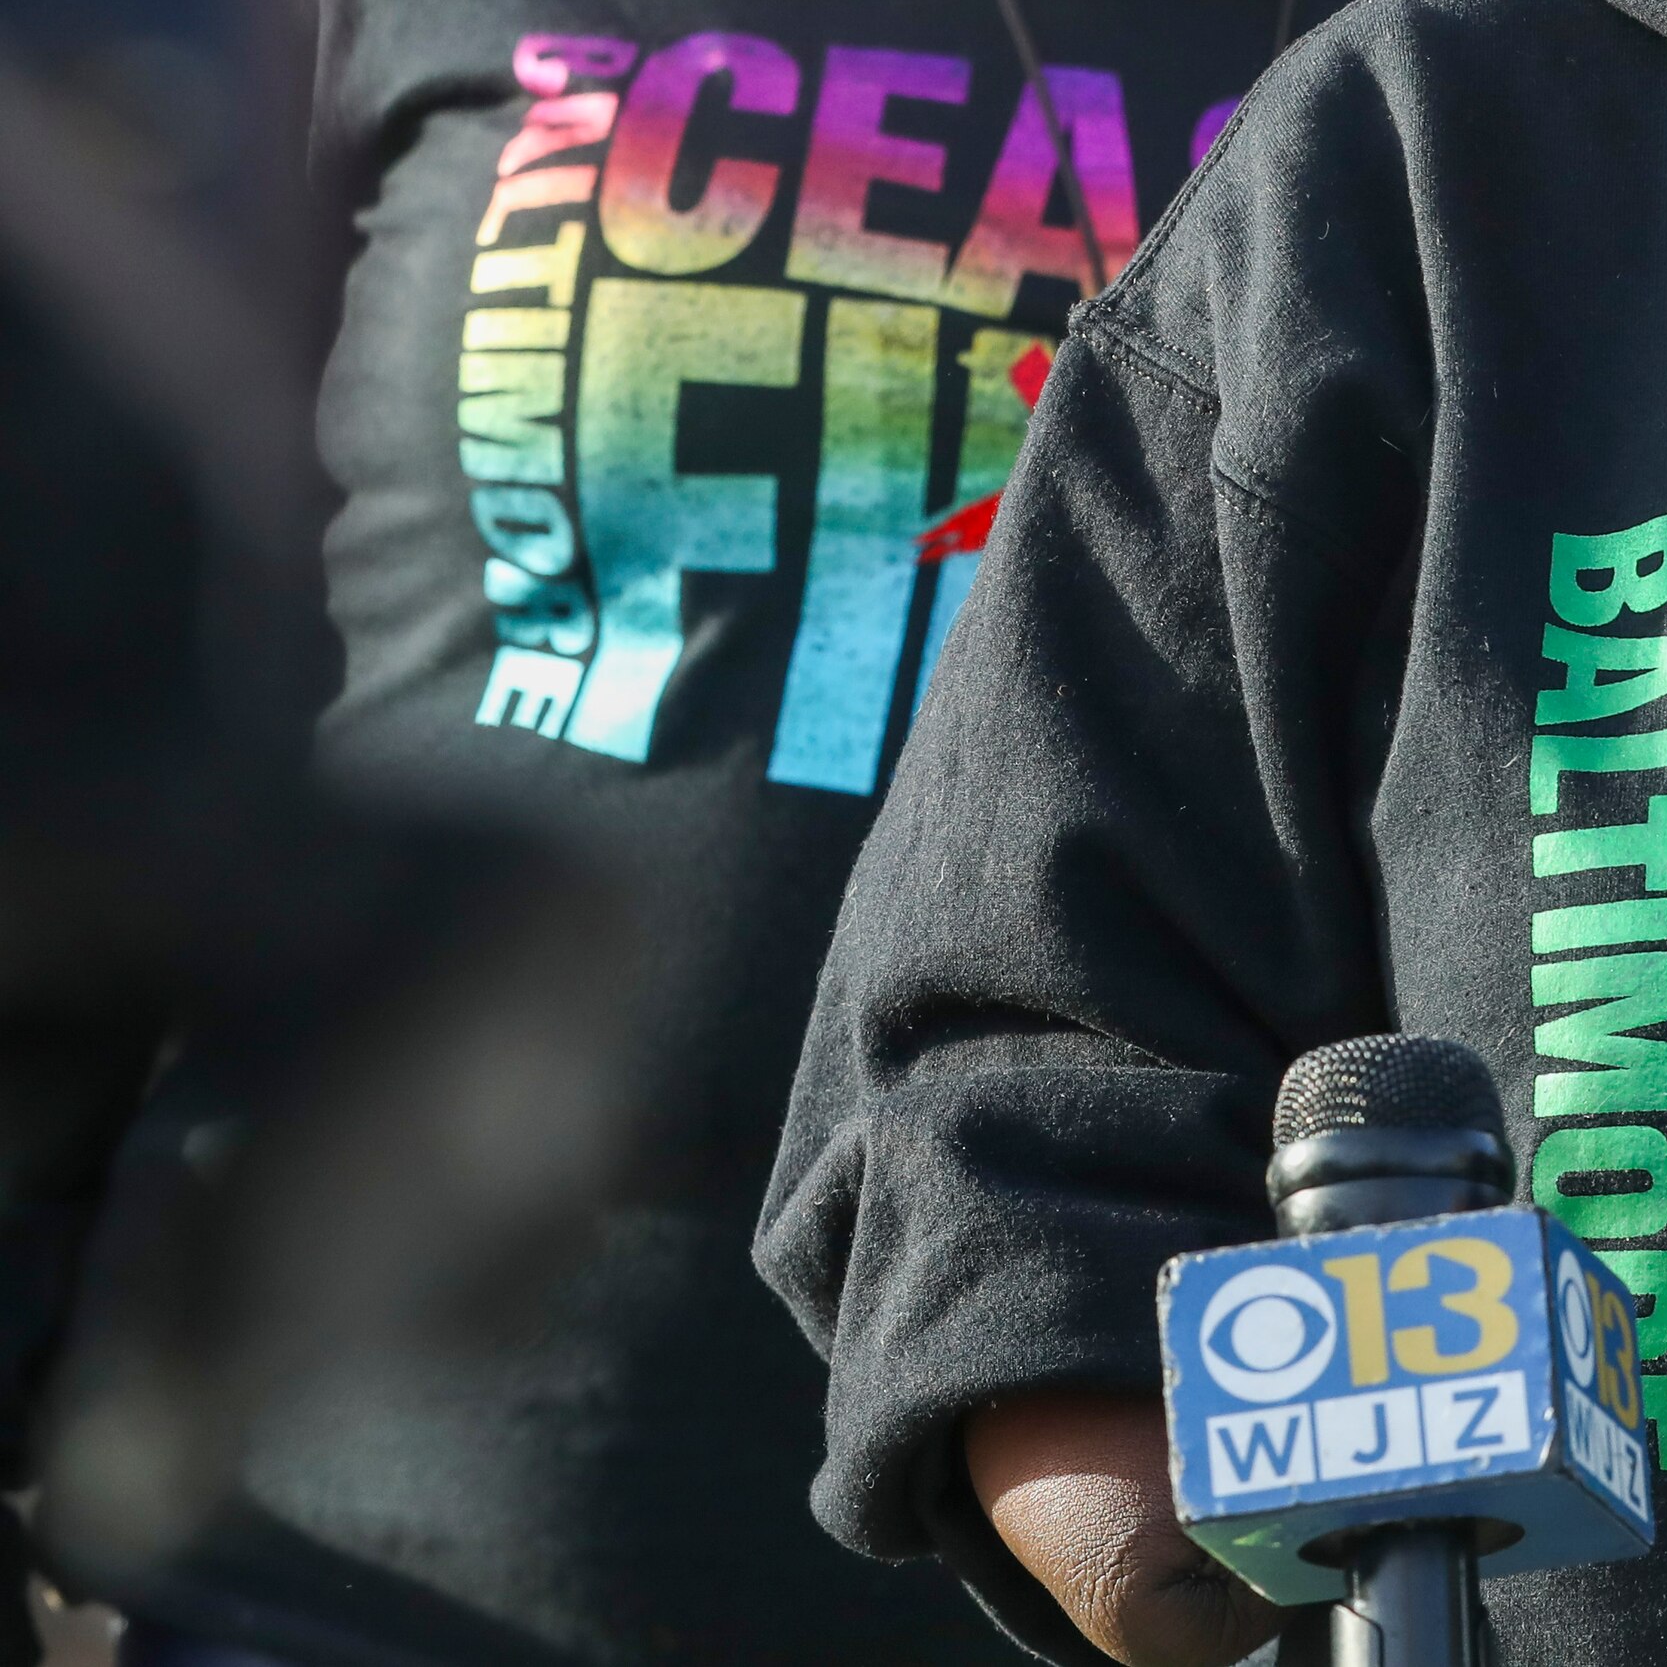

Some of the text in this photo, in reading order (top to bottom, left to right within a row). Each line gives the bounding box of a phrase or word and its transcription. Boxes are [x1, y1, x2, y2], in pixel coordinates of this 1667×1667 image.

[598, 31, 1242, 317] CEA
[562, 277, 1050, 797] FI
[1322, 1236, 1520, 1388] 13
[1586, 1271, 1639, 1430] 13
[1215, 1386, 1506, 1485] WJZ
